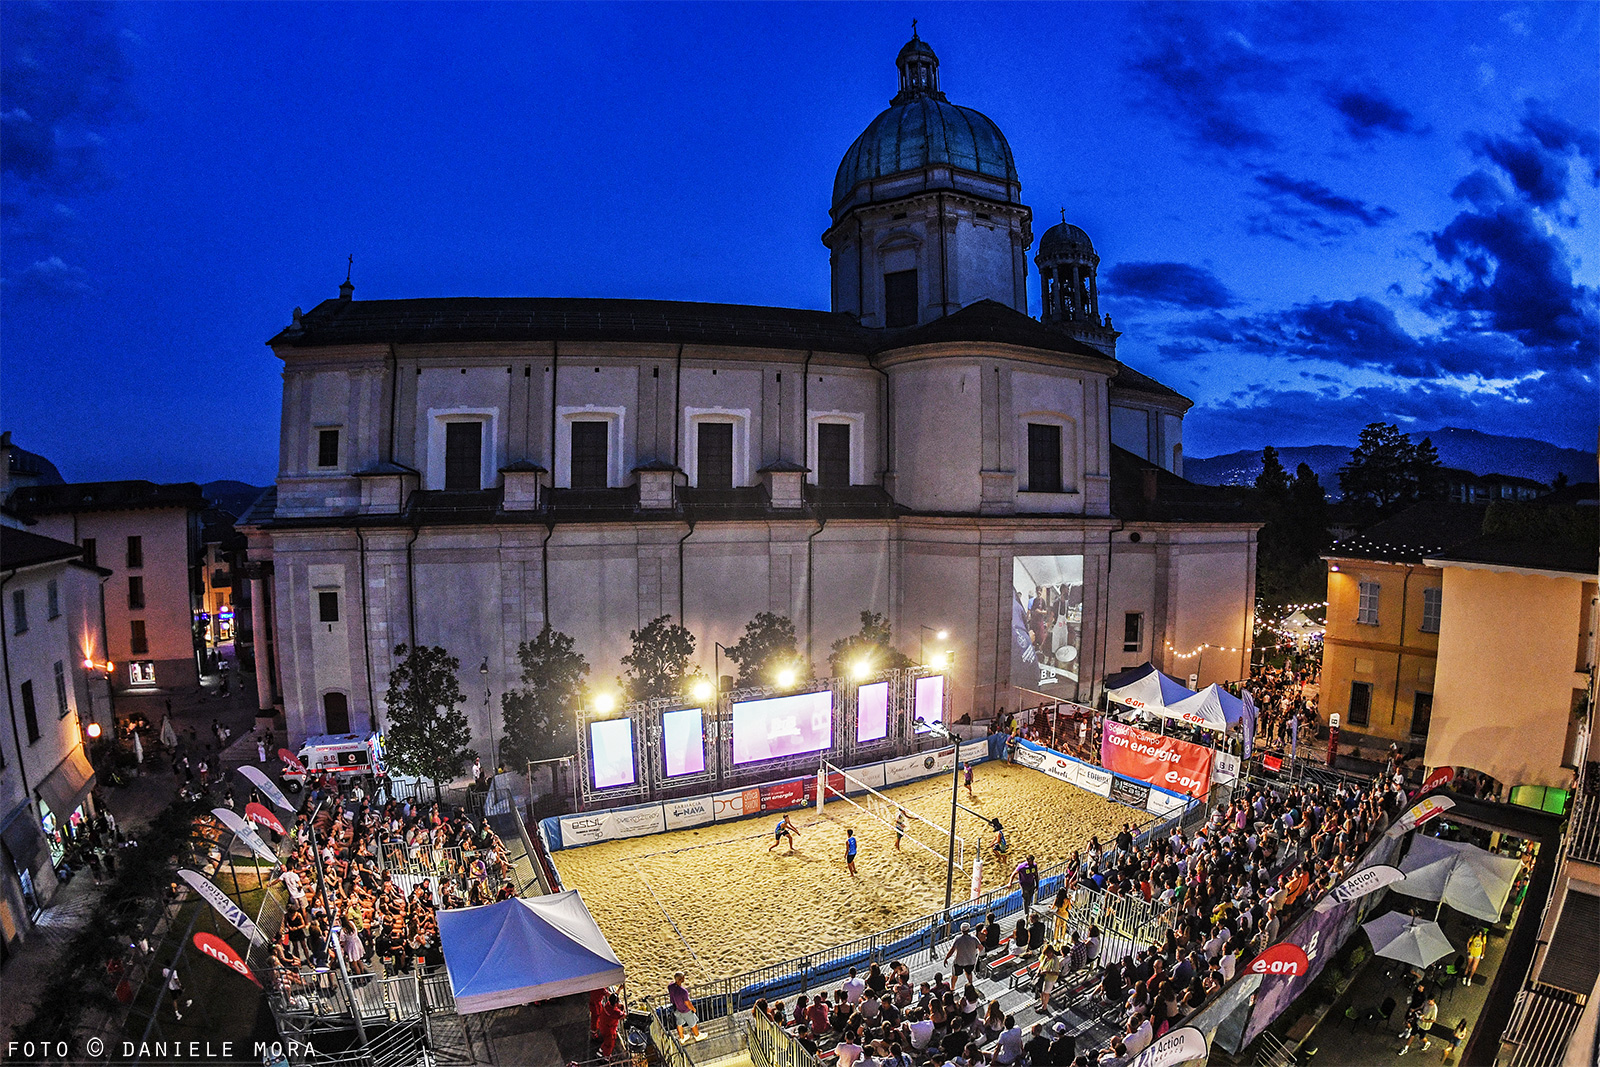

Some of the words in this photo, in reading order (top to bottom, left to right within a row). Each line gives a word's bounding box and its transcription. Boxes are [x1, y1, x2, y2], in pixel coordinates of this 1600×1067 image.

[1108, 734, 1129, 749] con
[1130, 742, 1182, 764] energia
[1136, 734, 1160, 746] campo
[683, 806, 705, 815] NAVA
[1347, 870, 1376, 890] Action
[1157, 1034, 1185, 1053] Action
